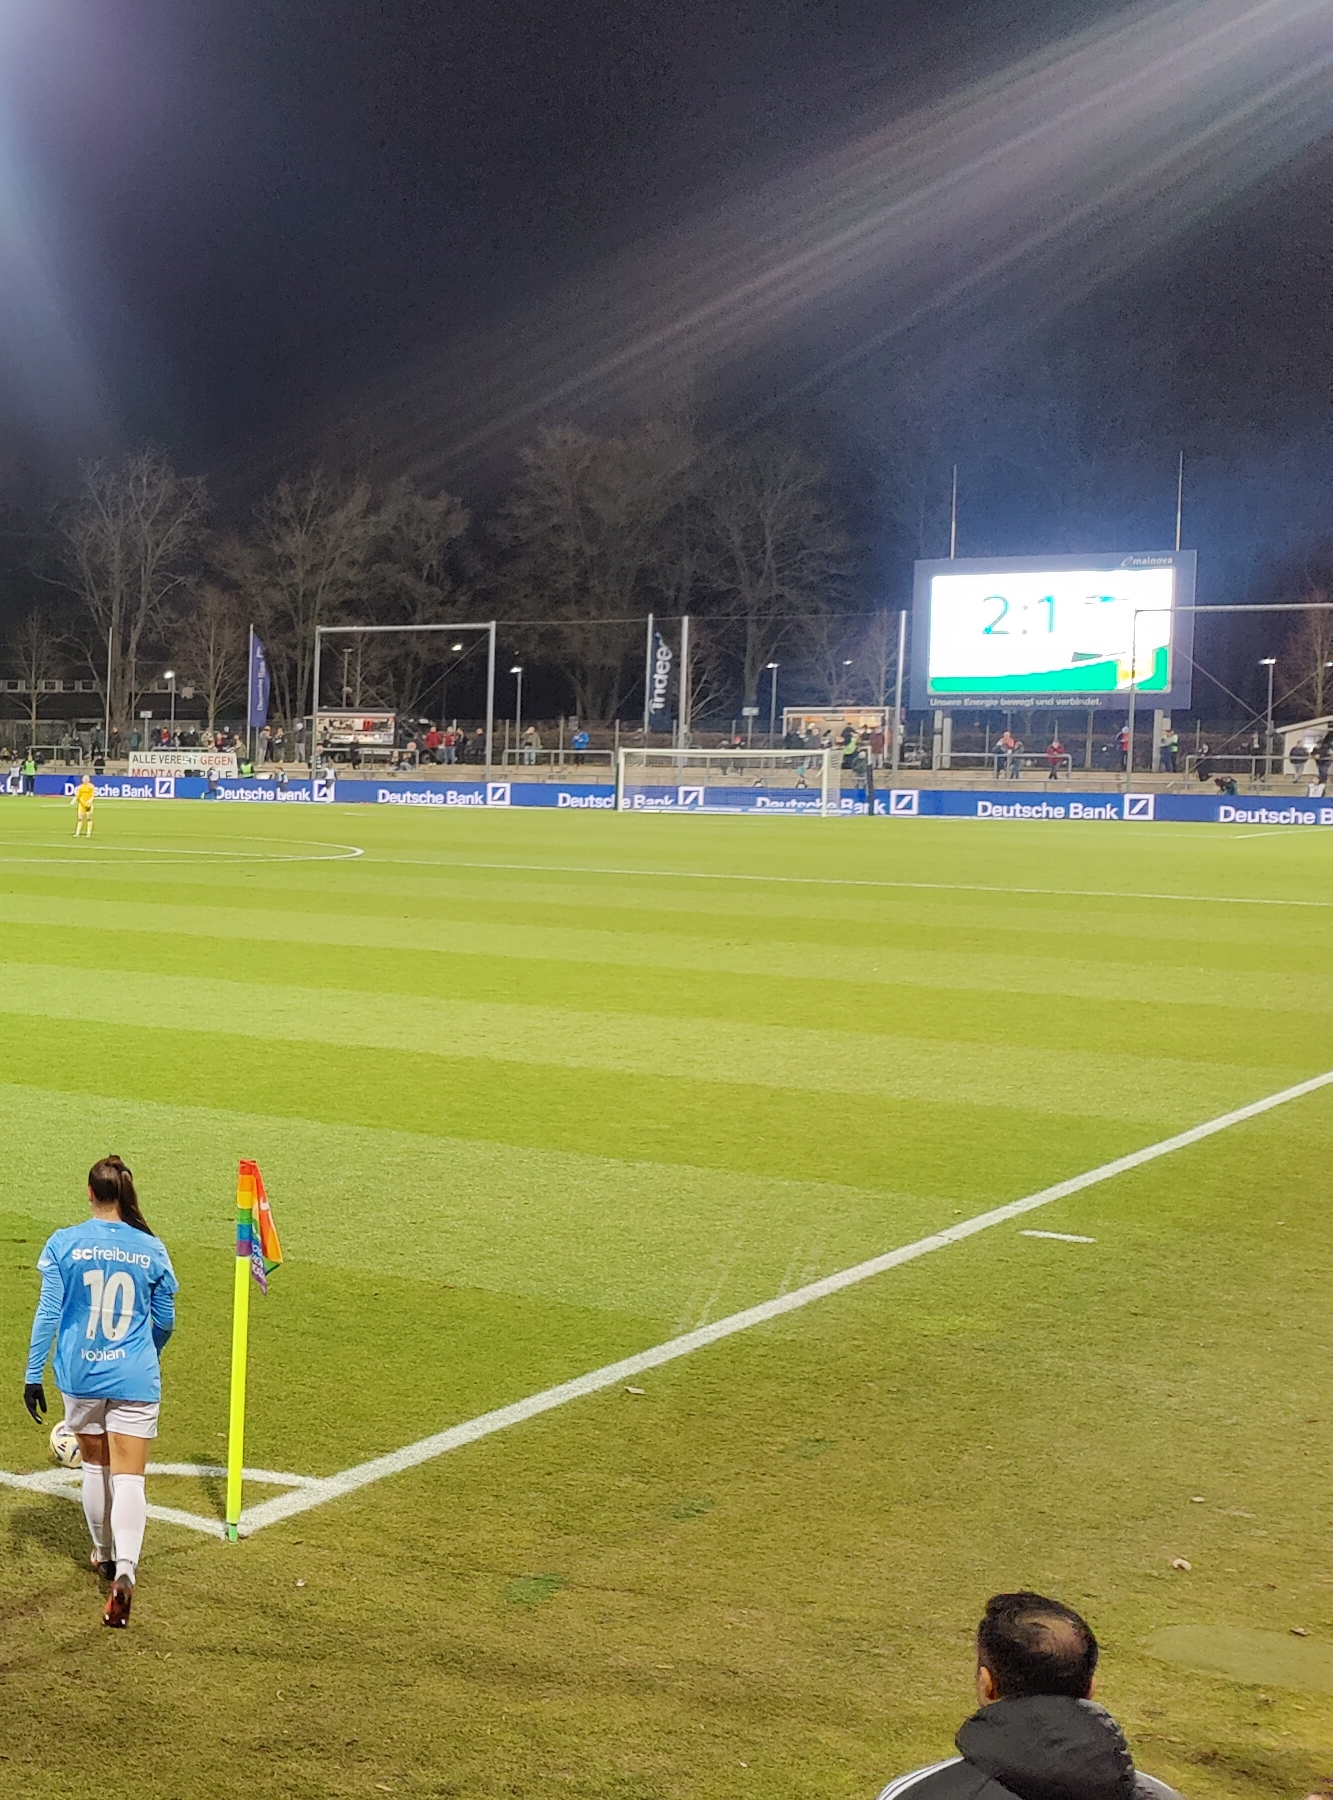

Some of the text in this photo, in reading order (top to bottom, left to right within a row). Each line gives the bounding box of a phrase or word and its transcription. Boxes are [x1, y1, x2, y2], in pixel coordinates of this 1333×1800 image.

[1132, 556, 1174, 566] mainova
[132, 755, 233, 765] ALLE VERET GEGEN
[64, 782, 153, 798] Dsche Bank
[377, 788, 484, 806] Deutsche Bank
[977, 800, 1120, 821] Deutsche Bank
[1219, 805, 1316, 825] Deutsche
[71, 1246, 152, 1269] scfreiburg
[82, 1269, 136, 1342] 10
